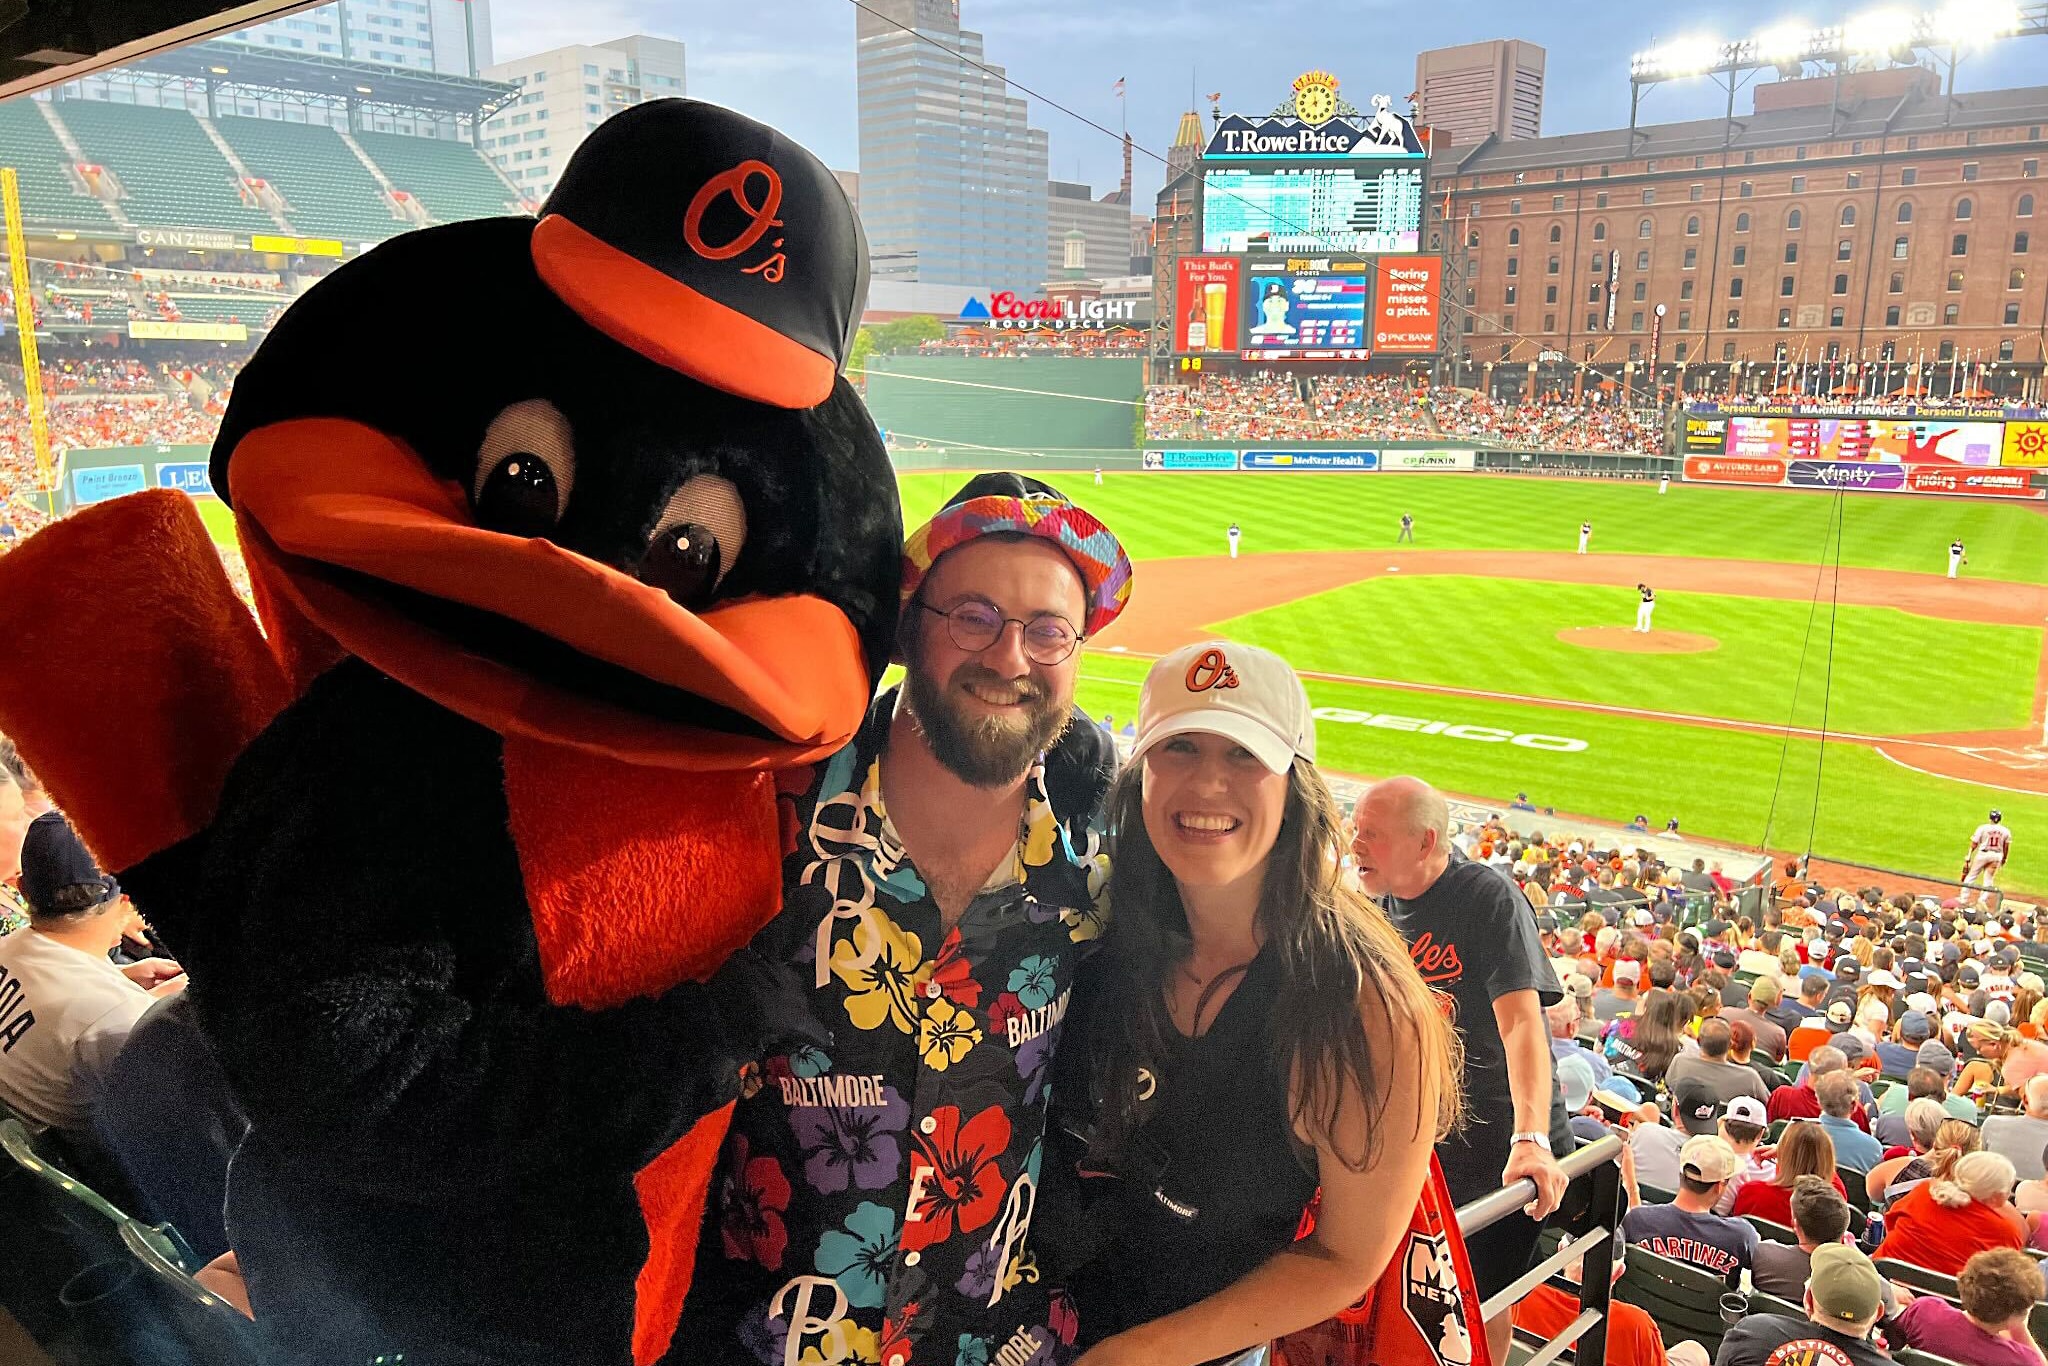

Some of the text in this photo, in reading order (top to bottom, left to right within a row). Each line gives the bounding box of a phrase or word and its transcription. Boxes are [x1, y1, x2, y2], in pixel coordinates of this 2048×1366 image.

[1292, 70, 1340, 91] ORIOLES
[1299, 130, 1350, 153] Price
[683, 159, 786, 283] O's
[138, 230, 196, 246] GANZ
[1184, 261, 1233, 270] This Bud's
[1189, 272, 1227, 281] For You.
[1389, 268, 1429, 282] Boring
[1391, 283, 1426, 292] never
[990, 290, 1137, 319] Coors LIGHT
[1387, 293, 1428, 304] misses
[1385, 305, 1431, 319] a pitch.
[988, 320, 1105, 329] ROOF DECK
[1387, 333, 1433, 342] PNC BANK
[1717, 404, 1793, 414] Personal Loans
[1800, 405, 1908, 417] MARINER FINANCE
[1915, 406, 2004, 418] Personal Loans
[1293, 456, 1364, 465] MedStar Health
[1713, 462, 1779, 473] AUTUMN LAKE
[1815, 464, 1876, 487] xfinity
[1915, 473, 1957, 490] HIGH'S
[1185, 648, 1240, 692] O's
[1311, 707, 1589, 752] GEICO
[1989, 836, 2000, 847] 11
[778, 1074, 889, 1107] BALTIMORE
[1775, 1340, 1850, 1366] BALTIMO
